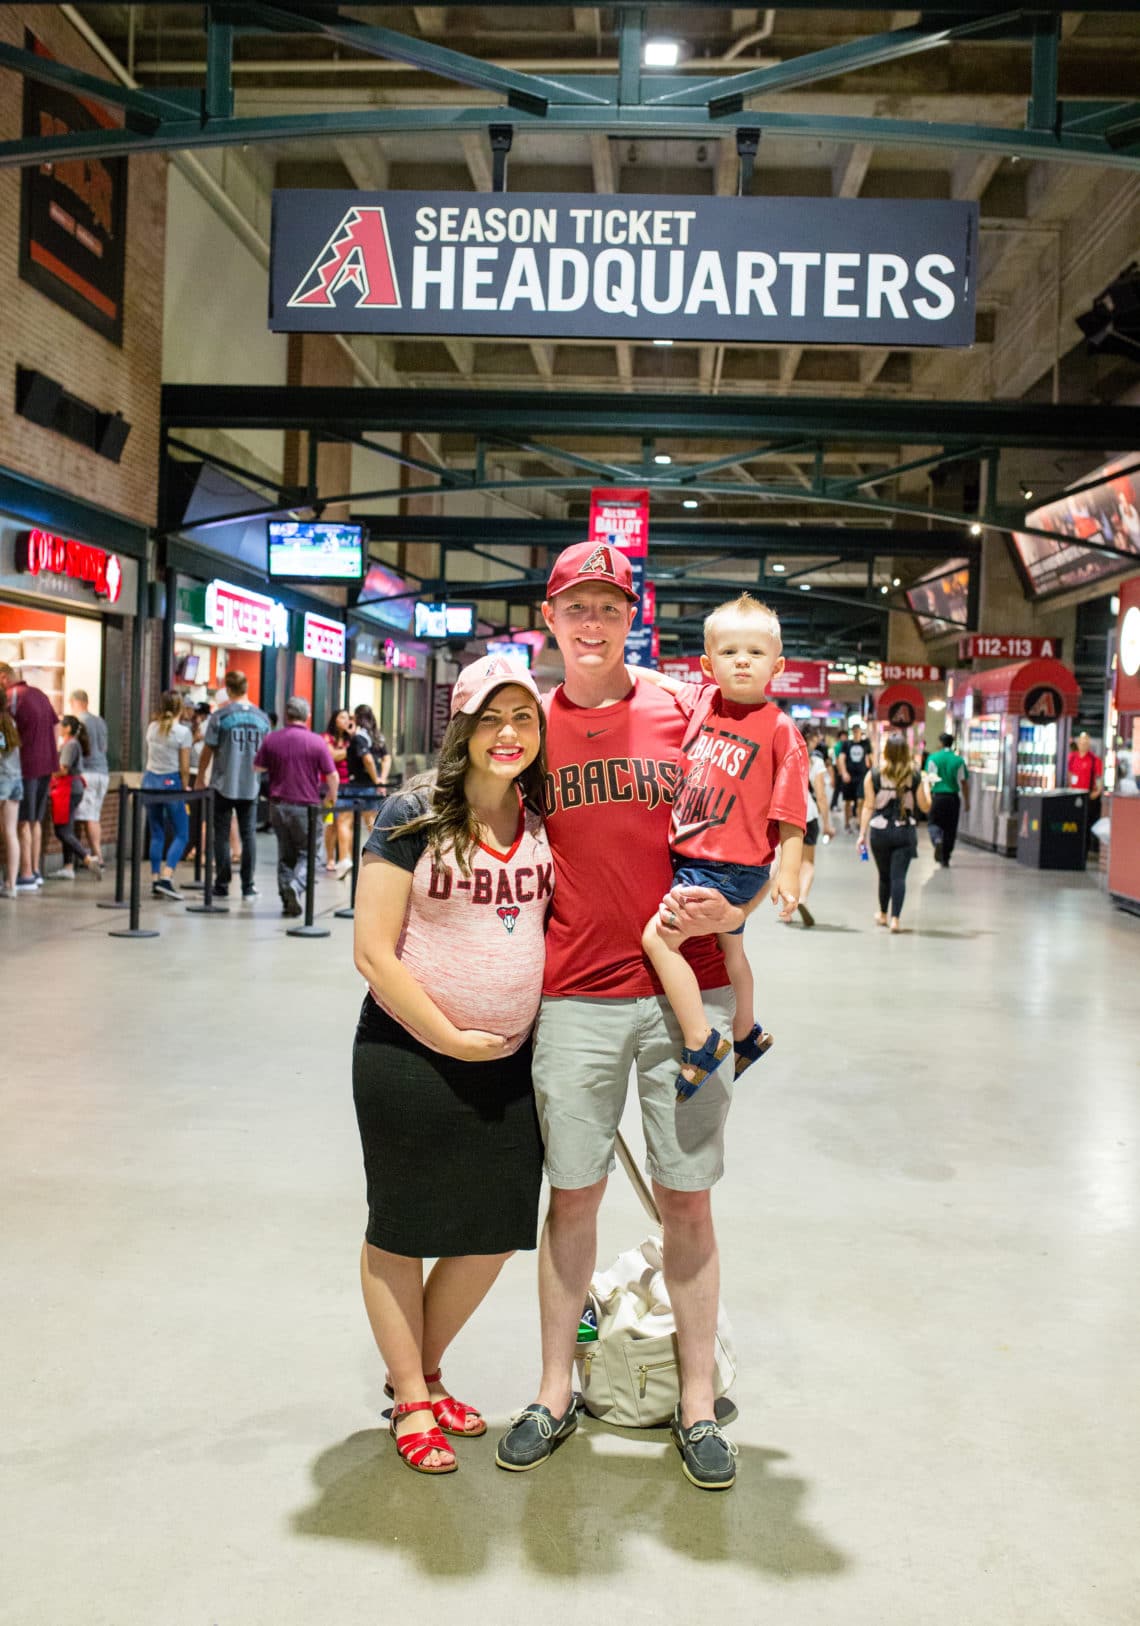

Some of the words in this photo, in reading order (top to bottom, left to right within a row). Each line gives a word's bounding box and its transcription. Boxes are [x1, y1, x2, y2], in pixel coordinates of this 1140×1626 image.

[414, 207, 557, 242] SEASON
[570, 209, 697, 245] TICKET
[411, 245, 955, 320] HEADQUARTERS
[976, 638, 1032, 657] 112-113
[1040, 639, 1054, 657] A
[884, 665, 924, 680] 113-114
[687, 734, 746, 777] BACKS
